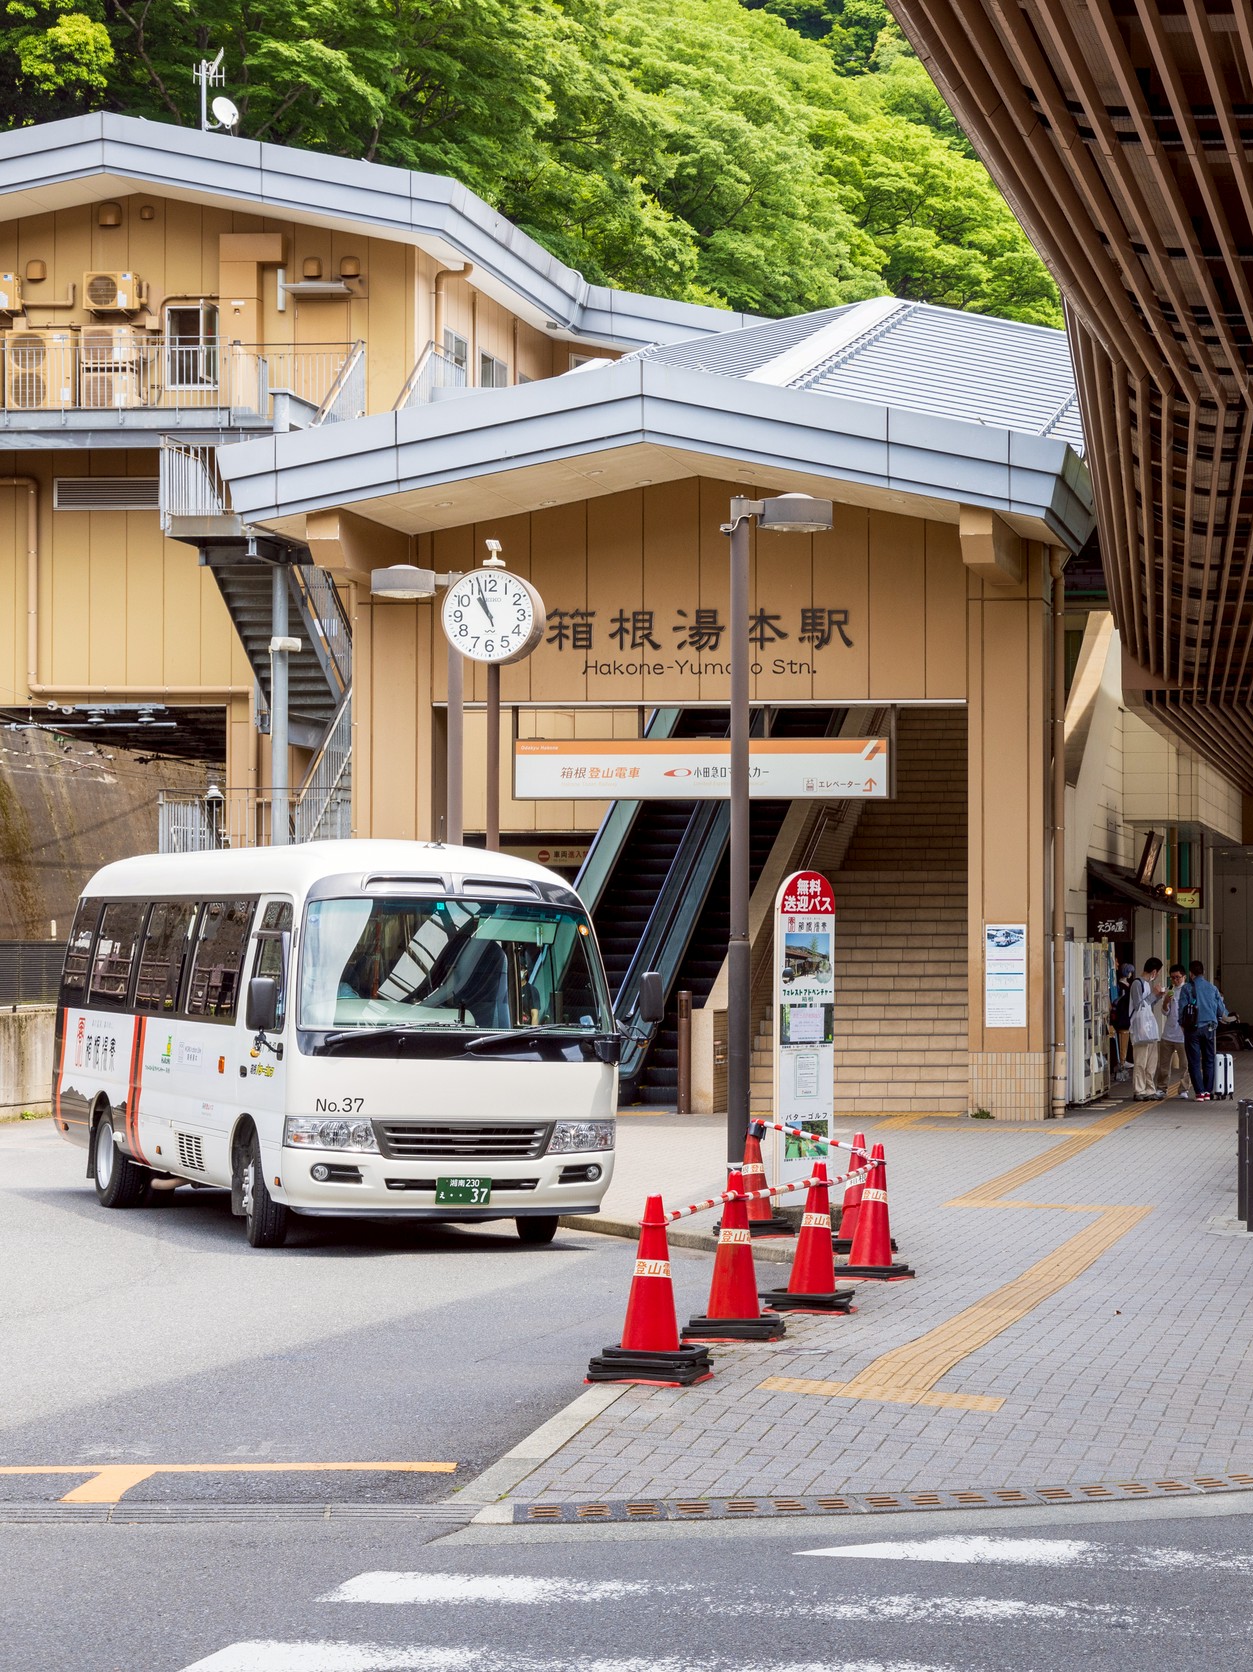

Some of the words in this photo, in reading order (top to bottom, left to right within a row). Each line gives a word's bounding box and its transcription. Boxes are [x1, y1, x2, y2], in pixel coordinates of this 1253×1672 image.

[485, 579, 498, 593] 12
[457, 594, 471, 608] 10
[513, 593, 522, 606] 2
[453, 610, 463, 623] 9
[516, 608, 526, 622] 3
[458, 624, 469, 638] 8
[511, 624, 522, 637] 4
[545, 607, 854, 652] 箱根湯本駅
[470, 636, 480, 649] 7
[484, 639, 494, 653] 6
[500, 636, 510, 649] 5
[771, 658, 817, 675] Stn.
[560, 766, 641, 779] 箱根登山電車
[818, 780, 861, 788] エレベーター
[796, 878, 822, 896] 無料
[783, 895, 833, 912] 送迎バス
[315, 1097, 365, 1113] No.37
[470, 1188, 488, 1203] 37
